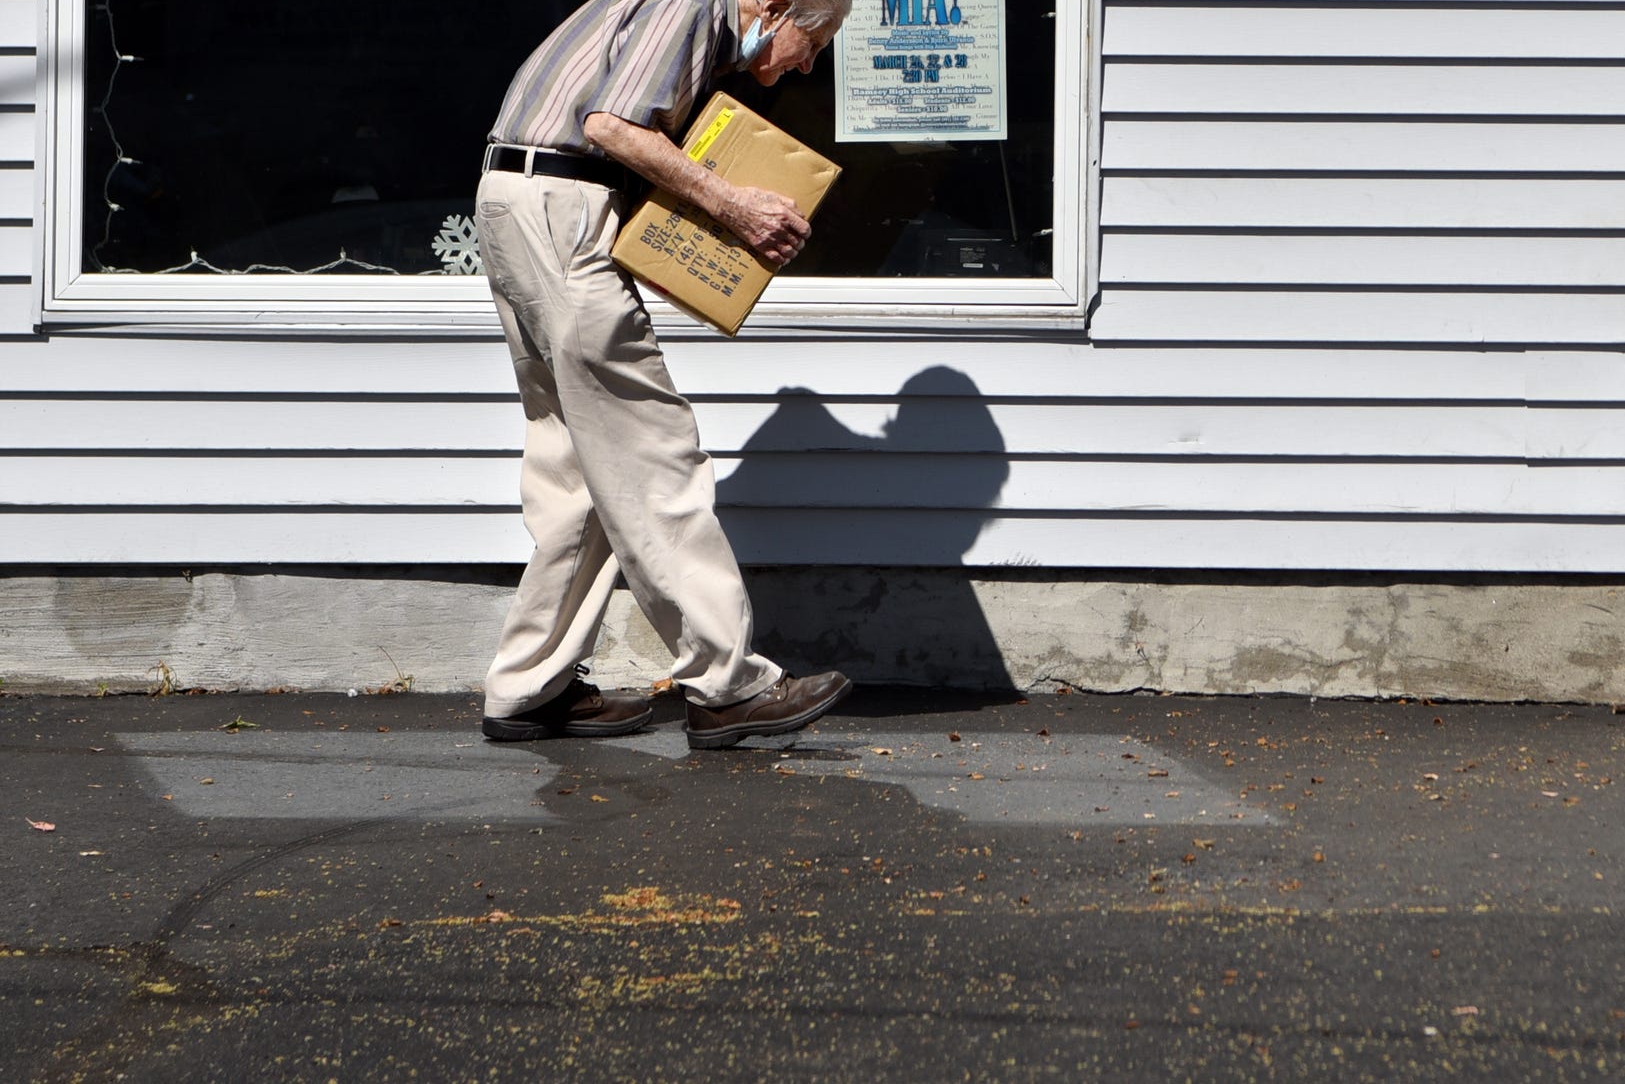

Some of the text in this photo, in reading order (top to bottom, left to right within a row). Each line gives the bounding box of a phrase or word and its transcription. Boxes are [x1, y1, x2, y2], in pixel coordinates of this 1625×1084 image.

[873, 55, 908, 70] MARCH
[943, 54, 953, 68] &
[954, 54, 968, 68] 28
[924, 69, 940, 83] PM
[852, 86, 992, 97] Ramsey High School Auditorium
[640, 222, 660, 245] BOX
